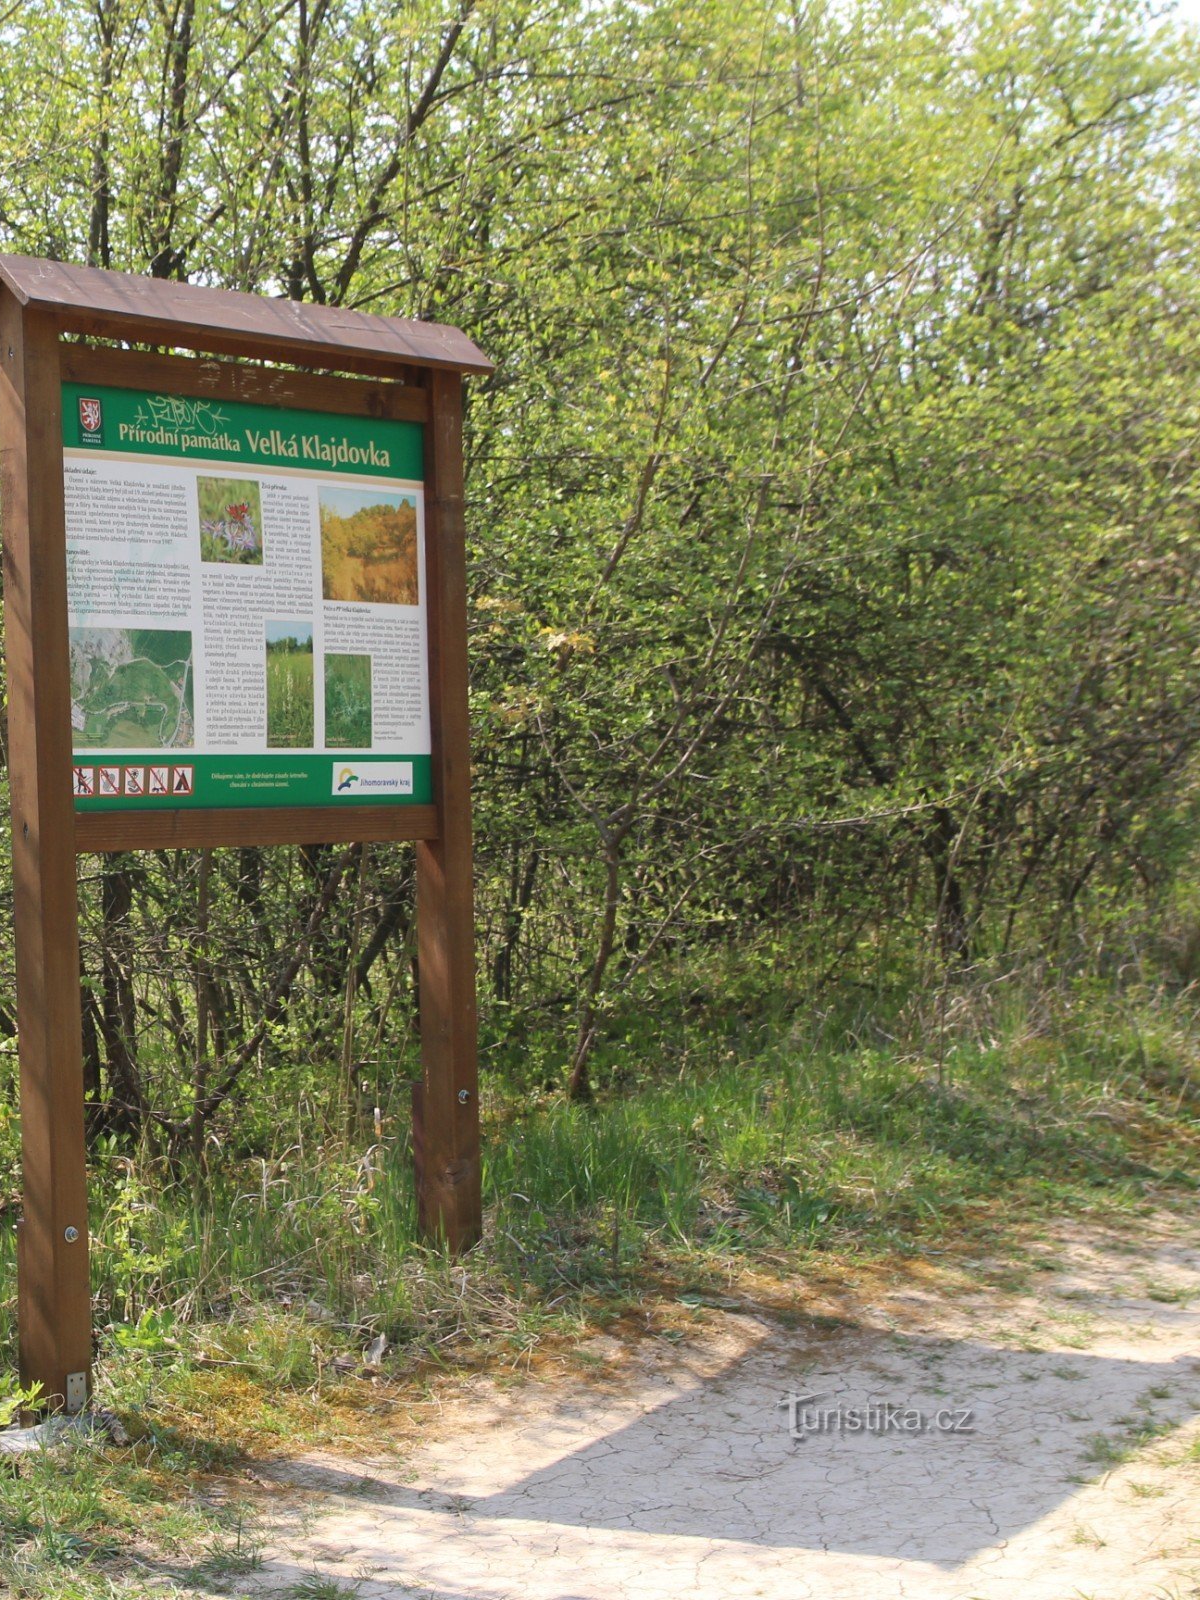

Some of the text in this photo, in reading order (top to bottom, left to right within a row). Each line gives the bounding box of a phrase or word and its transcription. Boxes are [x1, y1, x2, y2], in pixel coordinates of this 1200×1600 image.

[119, 423, 390, 468] Přírodní památka Velká Klajdovka
[360, 778, 411, 788] Jihomoravský kraj
